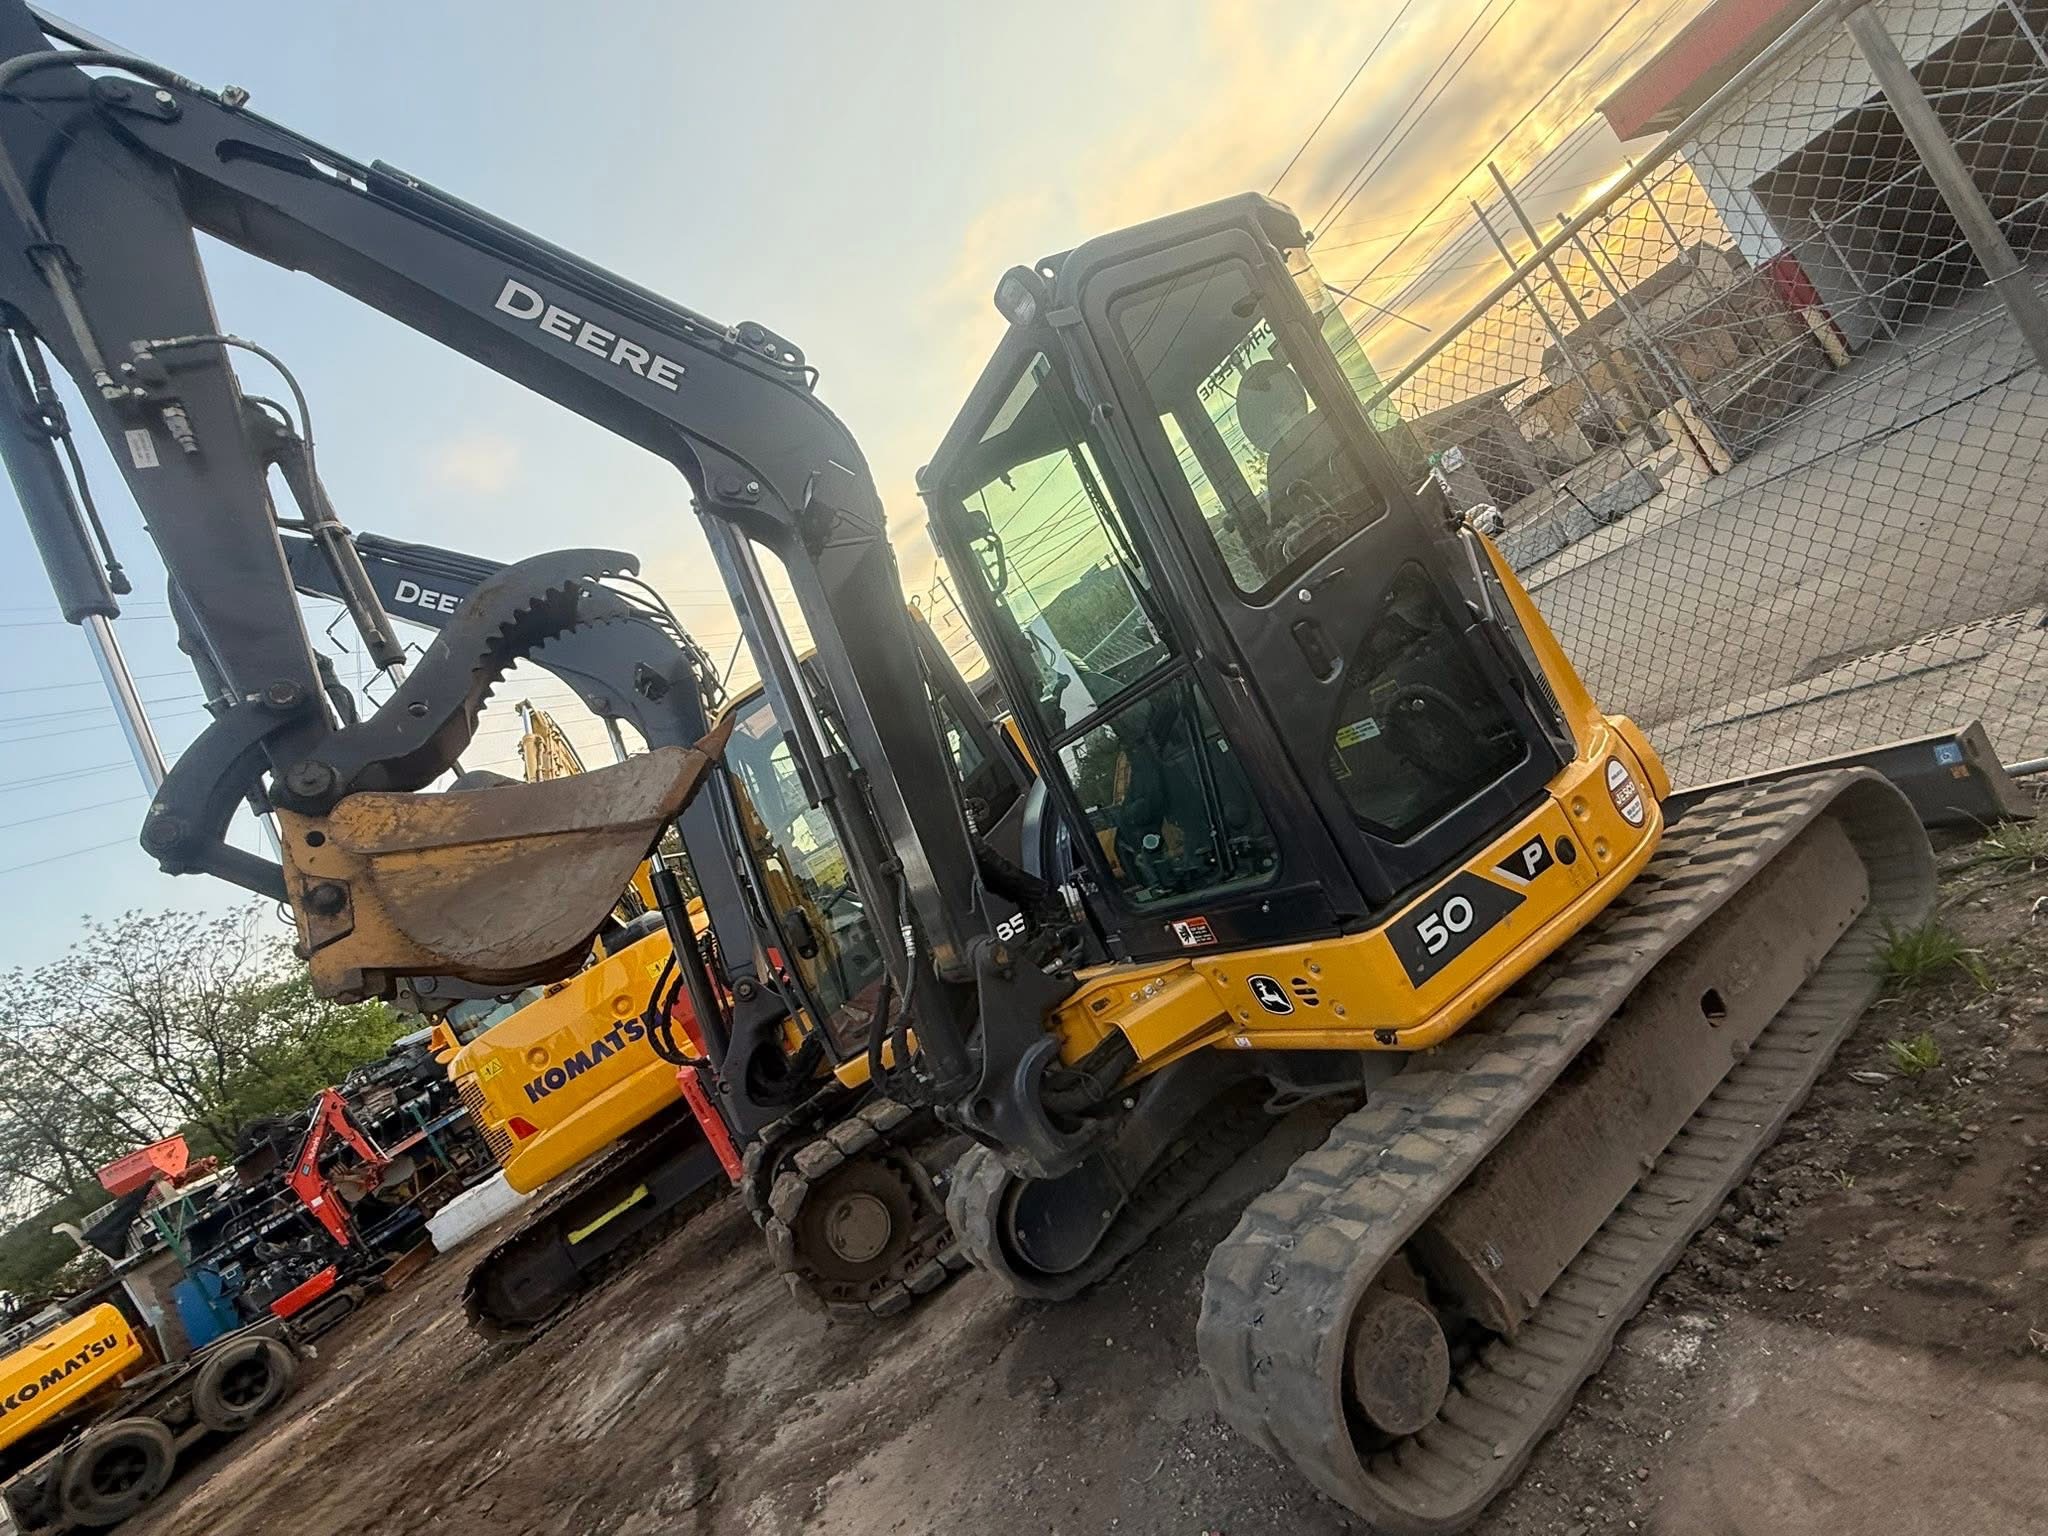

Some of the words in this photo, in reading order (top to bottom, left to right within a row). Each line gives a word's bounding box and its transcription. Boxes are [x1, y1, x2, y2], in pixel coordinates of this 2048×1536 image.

[495, 279, 685, 391] DEERE
[394, 579, 464, 614] DEE
[1616, 781, 1636, 805] JESCO
[1521, 841, 1543, 876] P
[995, 912, 1026, 942] 85
[1416, 896, 1474, 955] 50
[0, 1333, 118, 1418] KOMATSU
